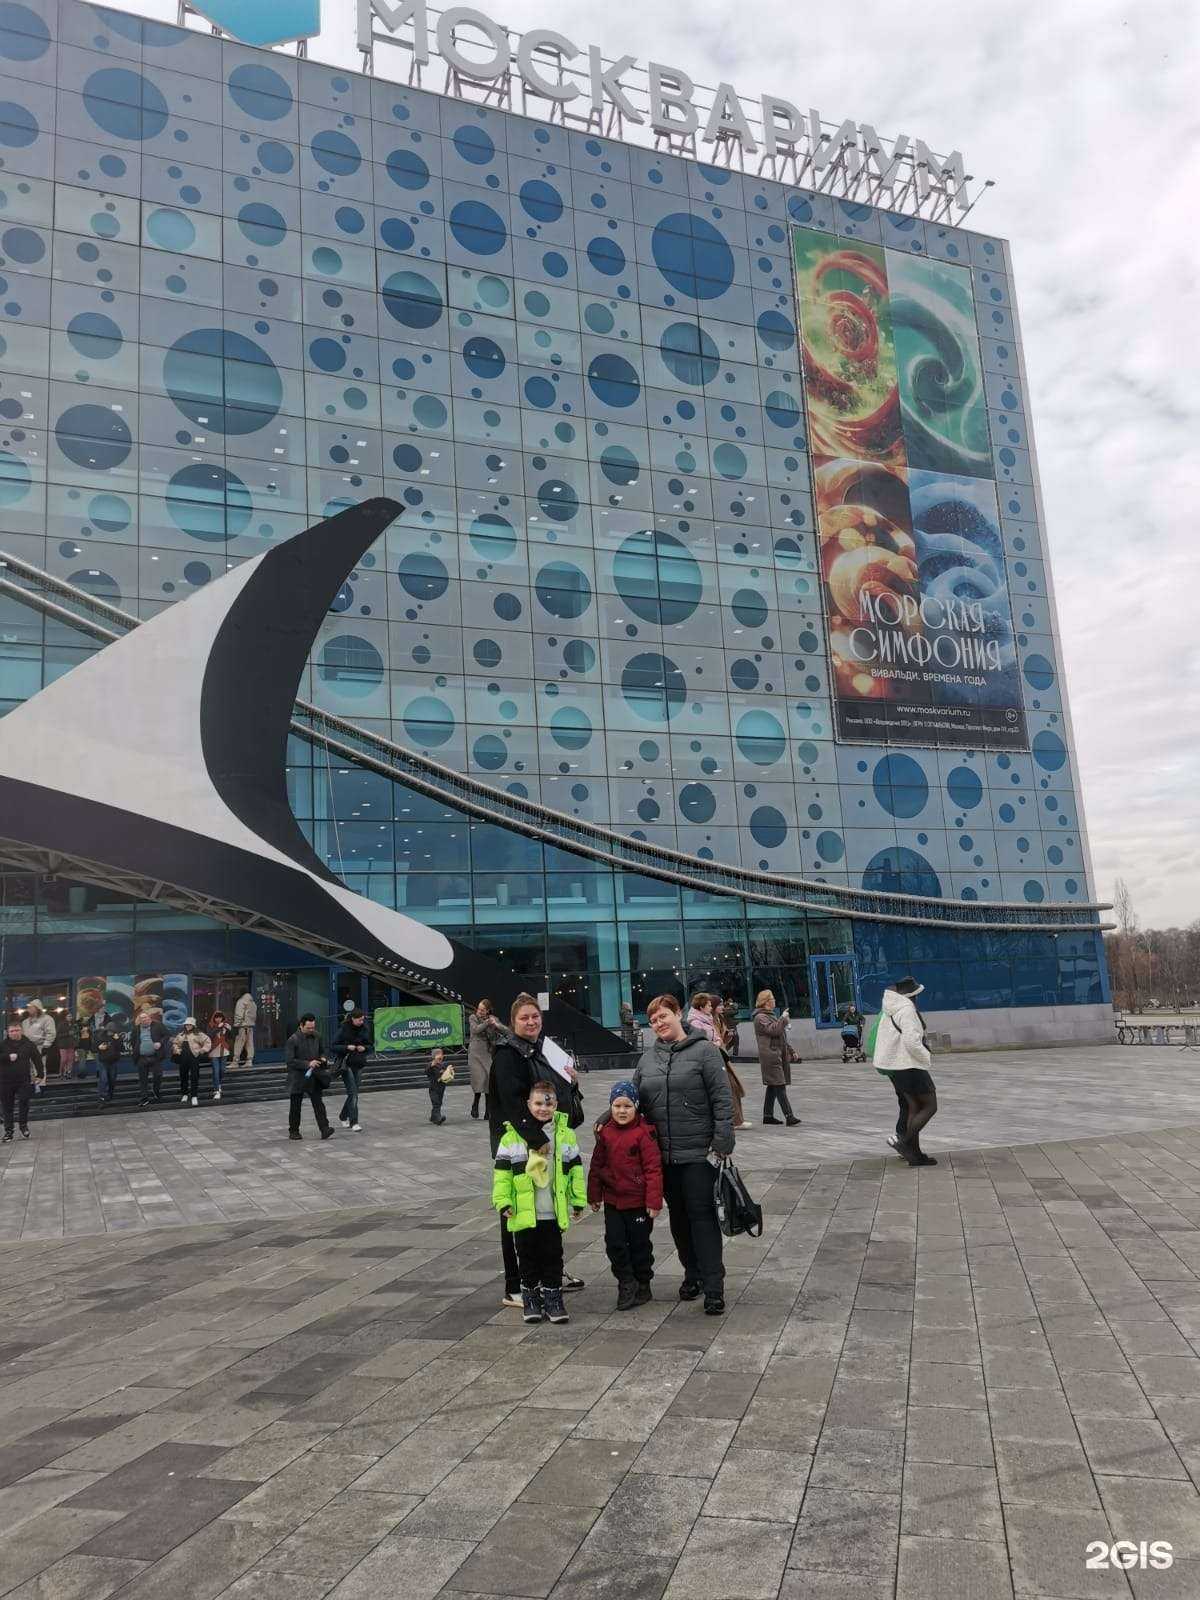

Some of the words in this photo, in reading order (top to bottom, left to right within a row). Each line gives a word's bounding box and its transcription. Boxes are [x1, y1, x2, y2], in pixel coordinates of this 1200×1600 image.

[357, 0, 968, 210] МОСКВАРИУМ
[860, 590, 985, 633] МОРСКАЯ
[850, 627, 1002, 671] СИМФОНИЯ
[923, 672, 961, 685] ВРЕМЕНА
[964, 675, 987, 687] ГОДА
[896, 705, 971, 717] www.moskvarium.ru
[408, 1020, 431, 1028] ВХОД
[399, 1027, 449, 1038] КОЛЯСКАМИ
